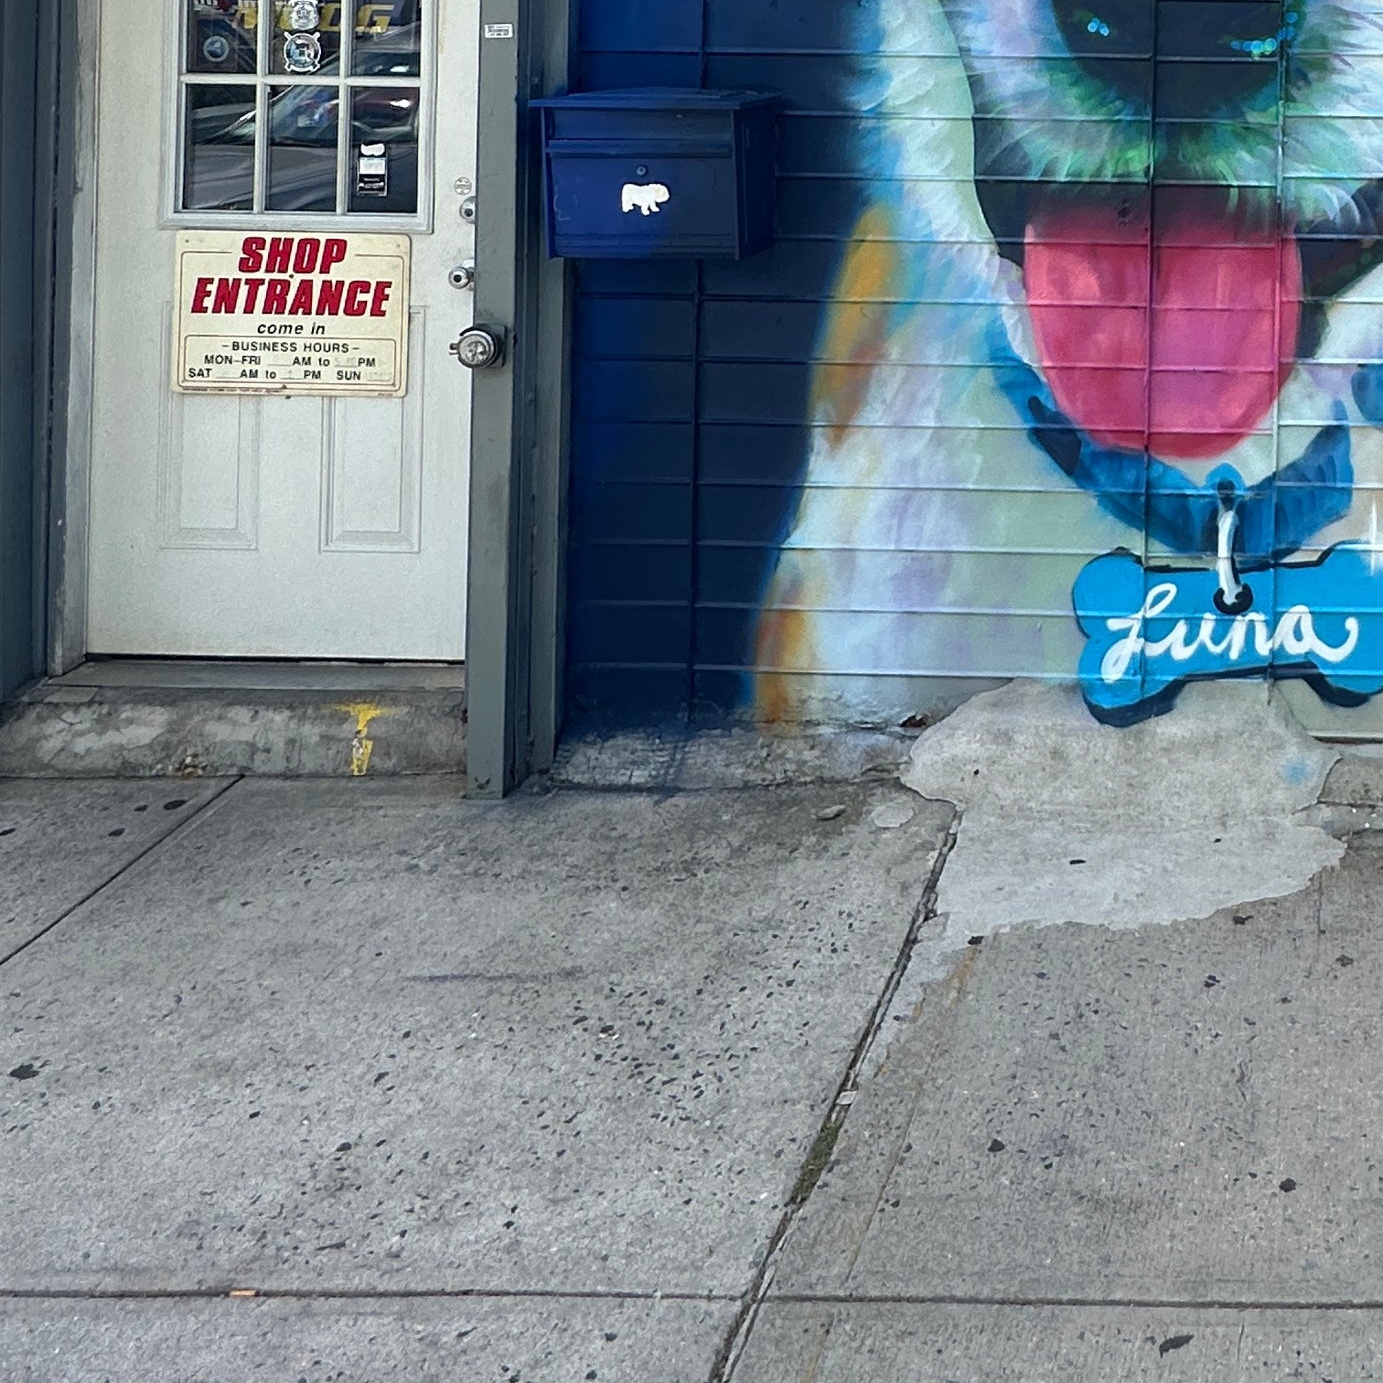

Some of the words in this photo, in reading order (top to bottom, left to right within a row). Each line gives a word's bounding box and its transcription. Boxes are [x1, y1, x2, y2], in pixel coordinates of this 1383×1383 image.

[238, 236, 348, 275] SHOP
[190, 277, 393, 317] ENTRANCE
[257, 323, 304, 335] come
[310, 321, 326, 335] in
[188, 367, 212, 378] SAT
[239, 369, 258, 379] AM
[265, 369, 277, 379] to
[303, 370, 321, 380] PM
[336, 370, 361, 380] SUN
[204, 355, 261, 365] MON-FRI
[292, 356, 312, 366] AM
[318, 356, 330, 367] to
[357, 357, 376, 367] PM
[1100, 582, 1359, 684] Luna
